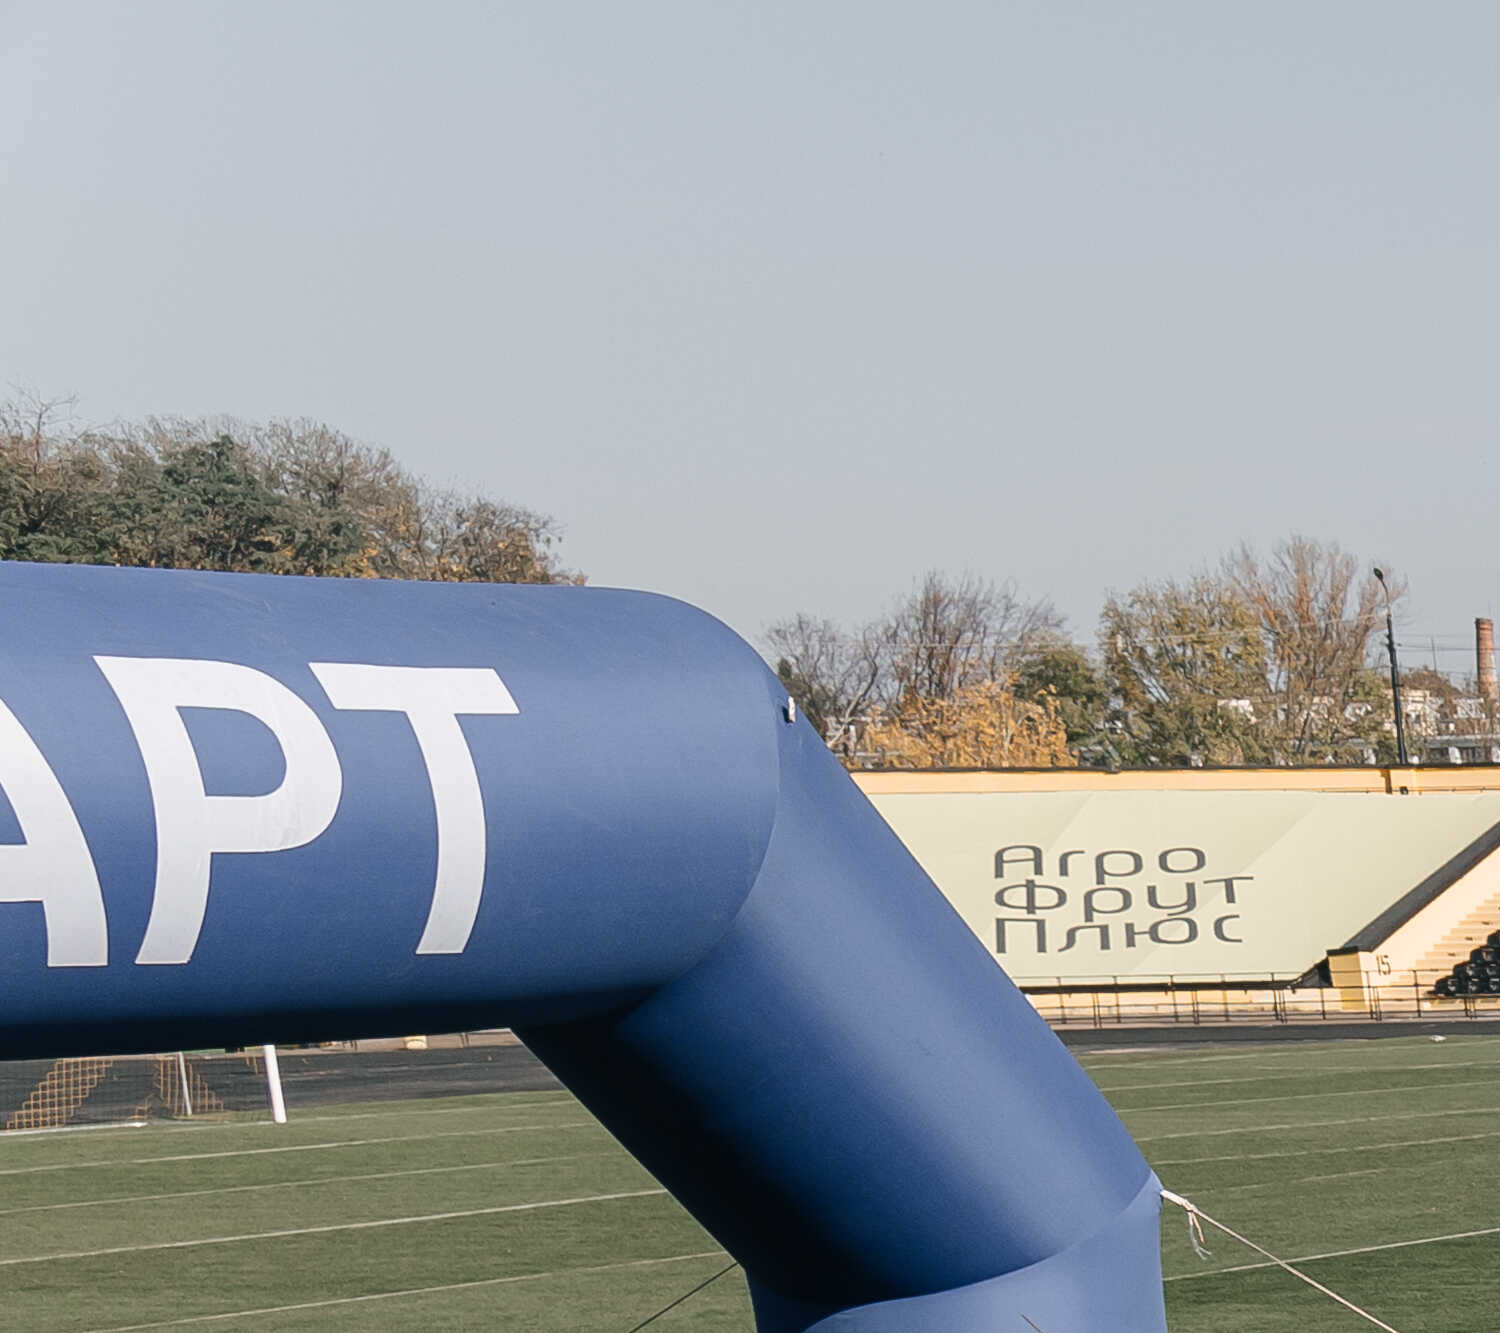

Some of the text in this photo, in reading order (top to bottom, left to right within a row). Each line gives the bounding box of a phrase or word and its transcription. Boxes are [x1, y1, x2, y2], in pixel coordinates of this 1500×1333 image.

[994, 845, 1206, 885] Агро
[994, 876, 1254, 923] Фрут
[994, 914, 1243, 954] Плюс
[1376, 954, 1391, 976] 15
